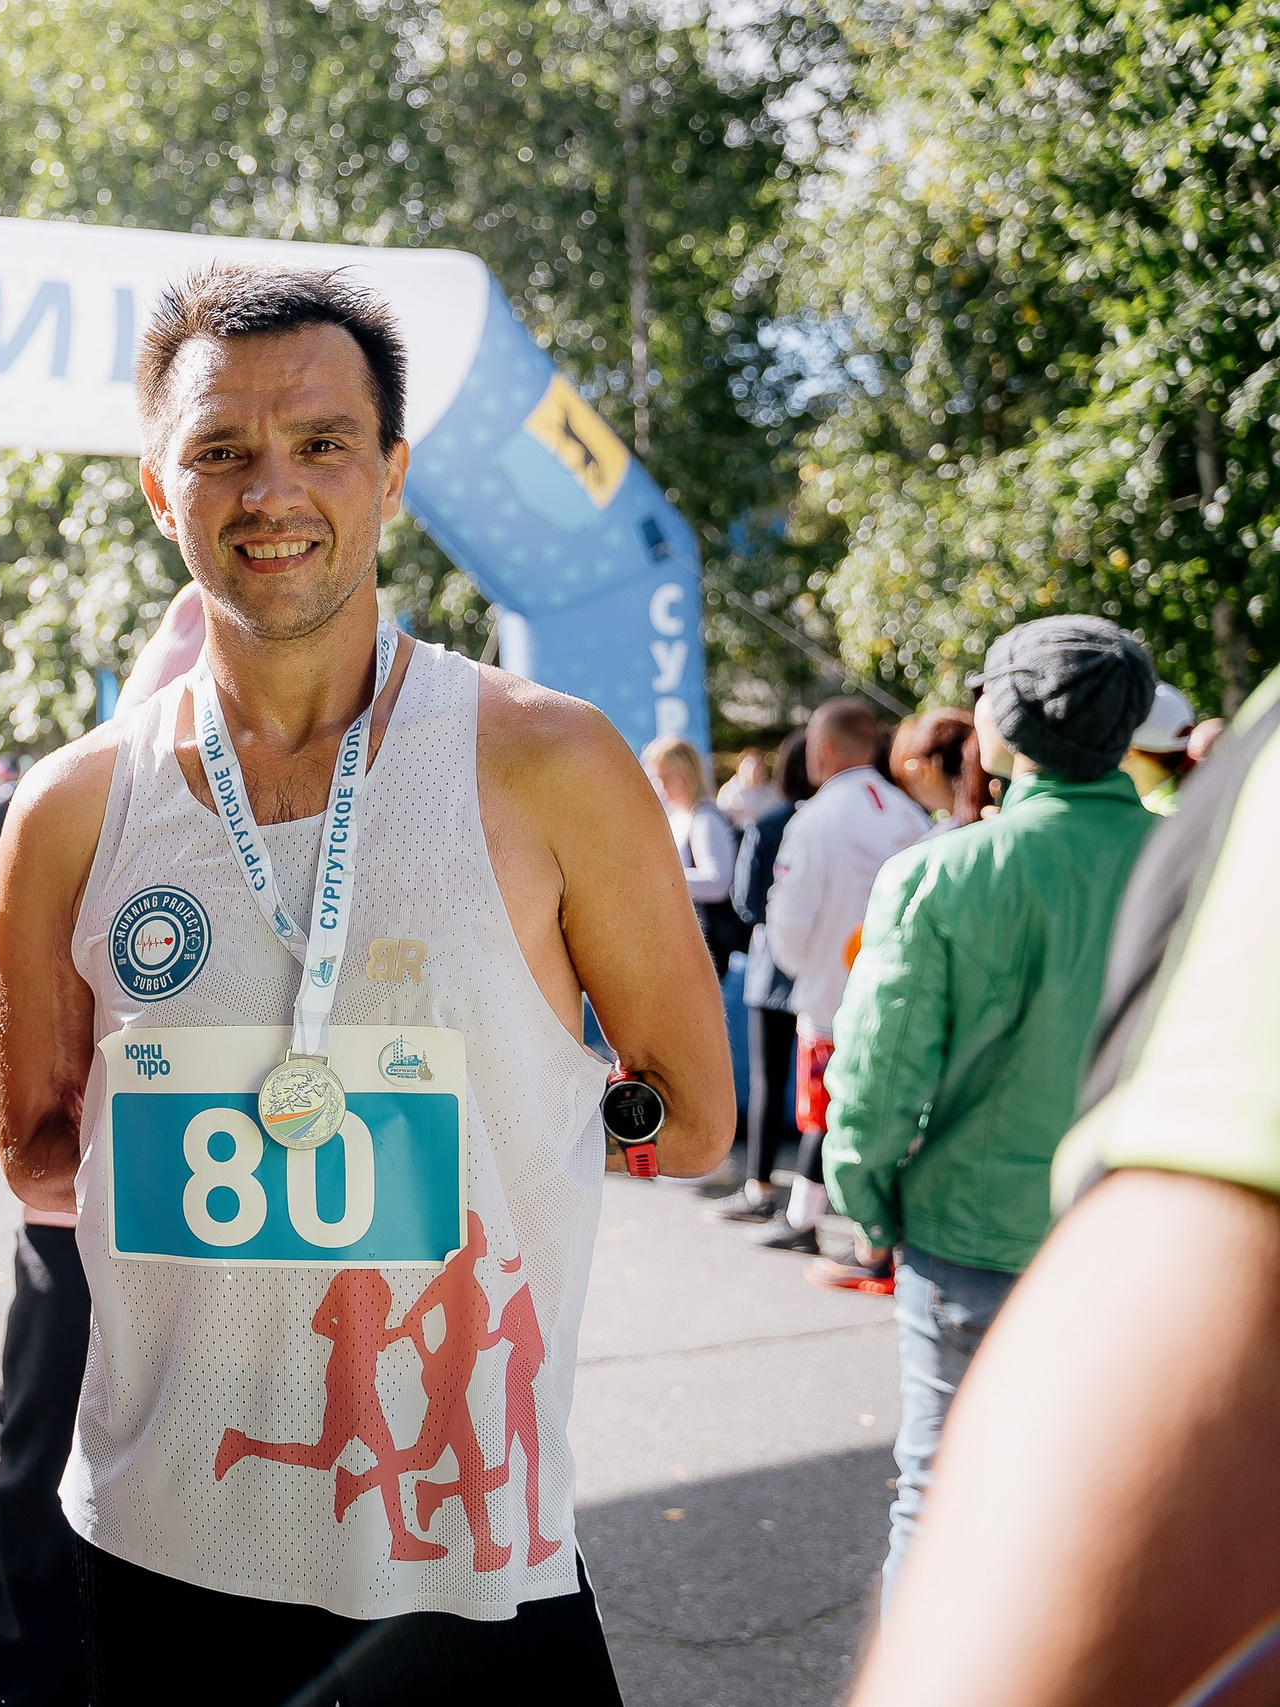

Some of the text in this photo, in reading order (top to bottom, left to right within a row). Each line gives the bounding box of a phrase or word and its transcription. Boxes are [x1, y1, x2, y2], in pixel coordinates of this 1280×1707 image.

[201, 698, 266, 892] СУРГУТСКОЕ КОЛЬ
[320, 787, 354, 930] СУРГУТСКОЕ
[340, 710, 368, 777] КОЛЬ
[116, 895, 201, 938] RUNNING PROJECT
[133, 972, 174, 991] SURGUT
[182, 1107, 376, 1249] 80
